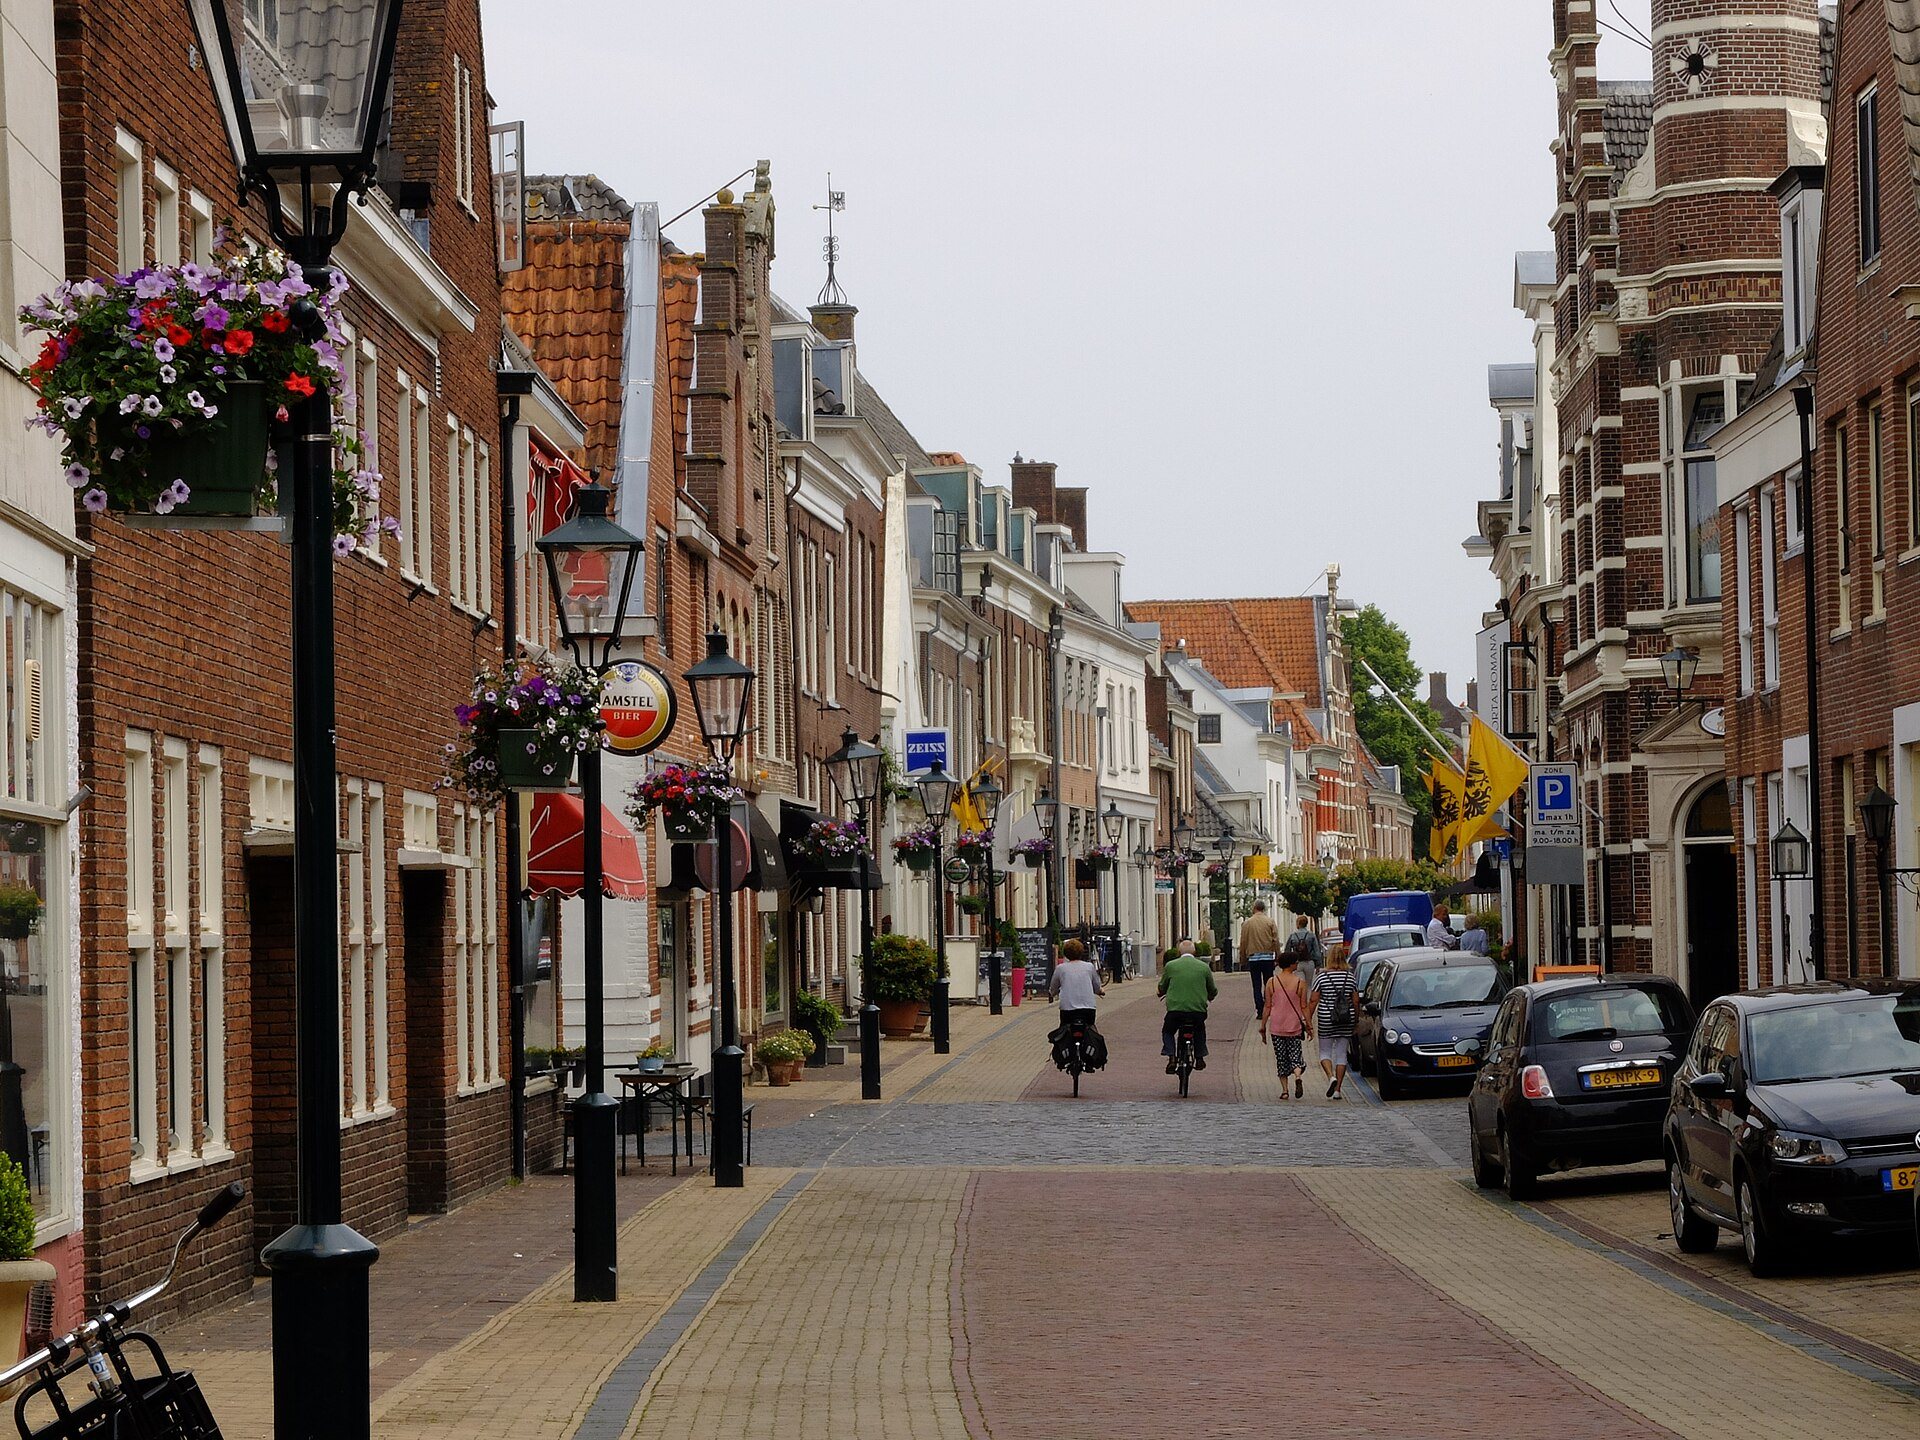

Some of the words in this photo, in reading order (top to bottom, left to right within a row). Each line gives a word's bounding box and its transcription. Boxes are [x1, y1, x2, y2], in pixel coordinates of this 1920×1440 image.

[1489, 633, 1498, 691] ROMANA
[602, 695, 653, 707] AMSTEL
[613, 711, 640, 721] BIER
[1491, 697, 1499, 731] ORTA
[908, 742, 945, 754] ZEISS
[1544, 779, 1564, 806] P
[1594, 1069, 1655, 1085] 86-NPK-9
